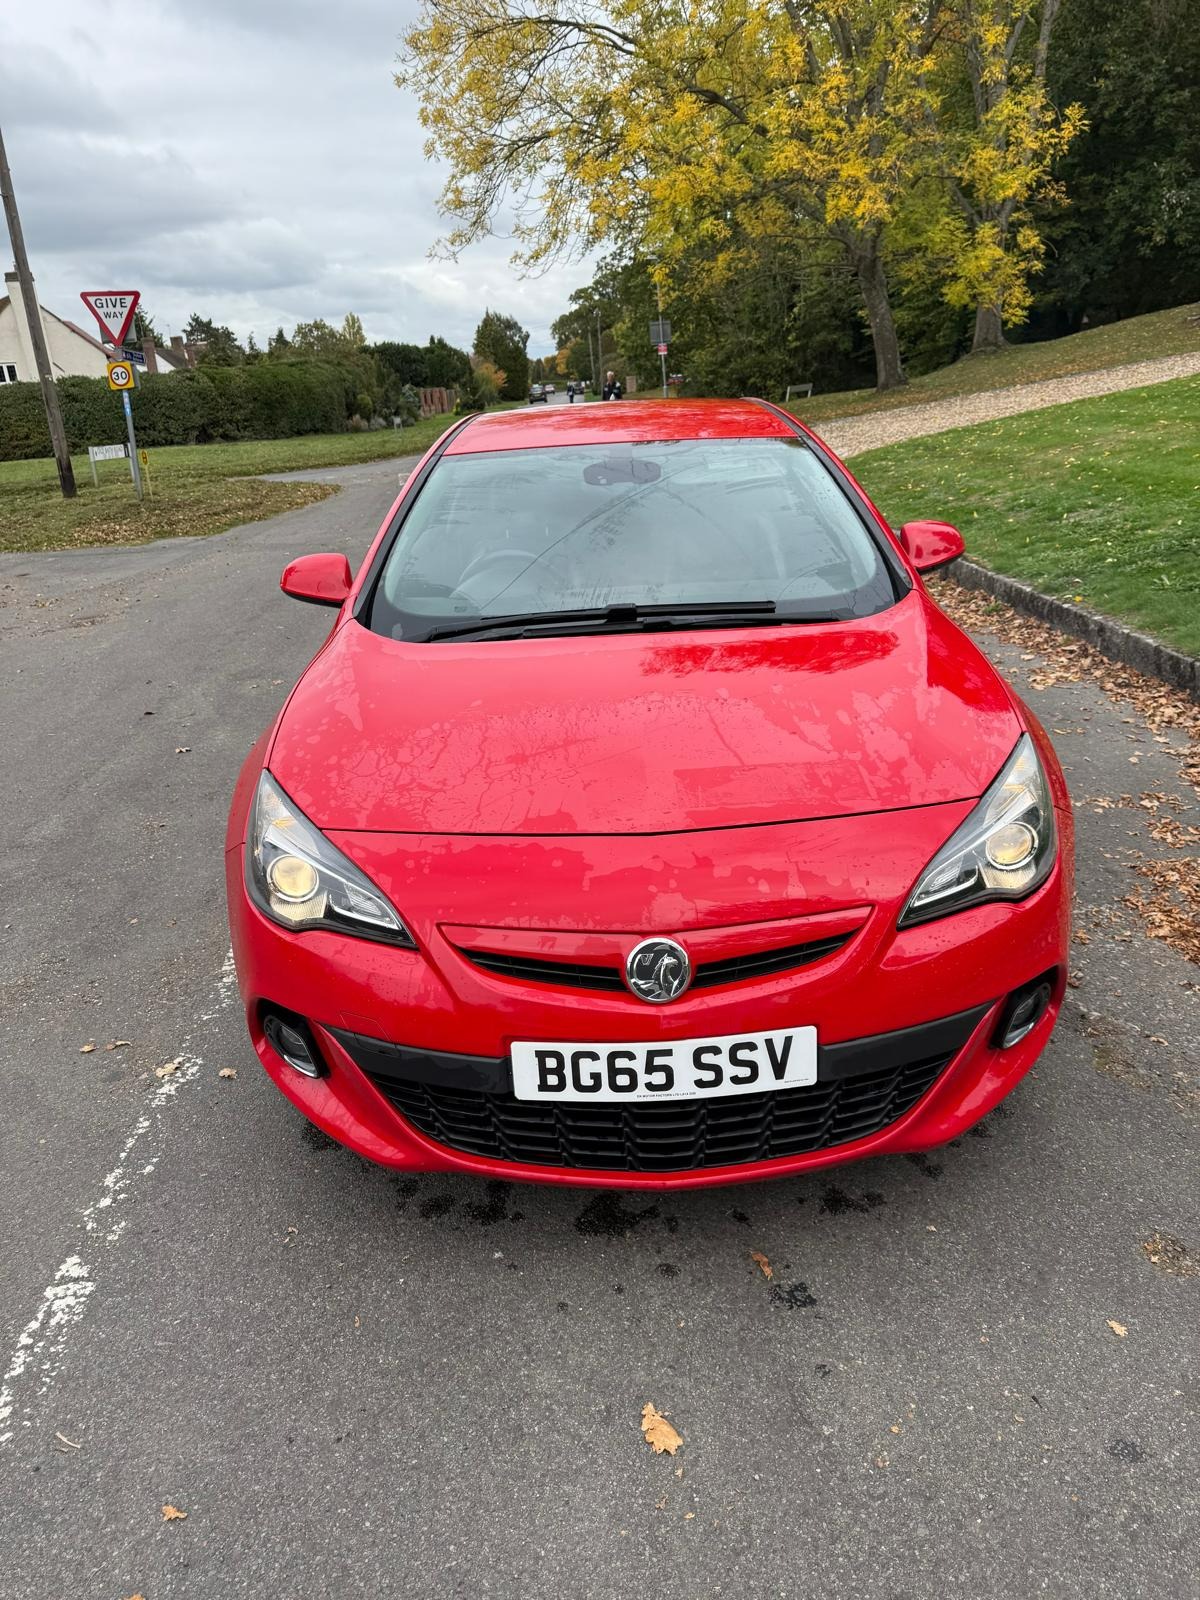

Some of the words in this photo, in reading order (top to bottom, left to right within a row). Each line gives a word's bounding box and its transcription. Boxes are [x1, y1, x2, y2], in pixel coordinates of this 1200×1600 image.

[94, 297, 128, 309] GIVE
[103, 311, 124, 319] WAY
[113, 371, 128, 381] 30
[534, 1048, 675, 1093] BG65
[692, 1035, 794, 1089] SSV
